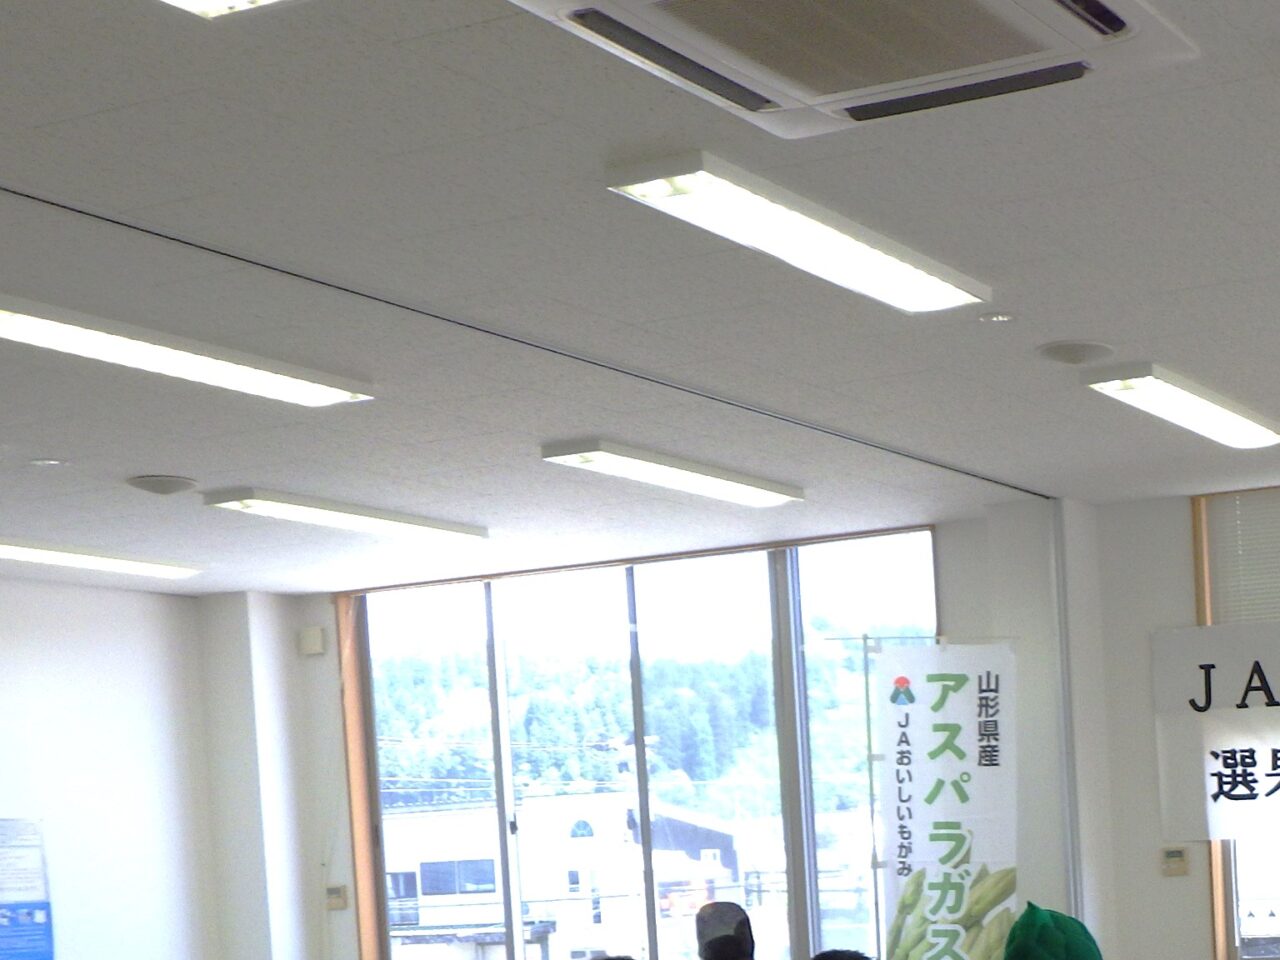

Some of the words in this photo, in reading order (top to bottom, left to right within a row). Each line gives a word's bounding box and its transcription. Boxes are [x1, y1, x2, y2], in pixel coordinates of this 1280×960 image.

[977, 671, 1000, 768] 山形県産
[895, 712, 914, 877] JAおいしいもがみ
